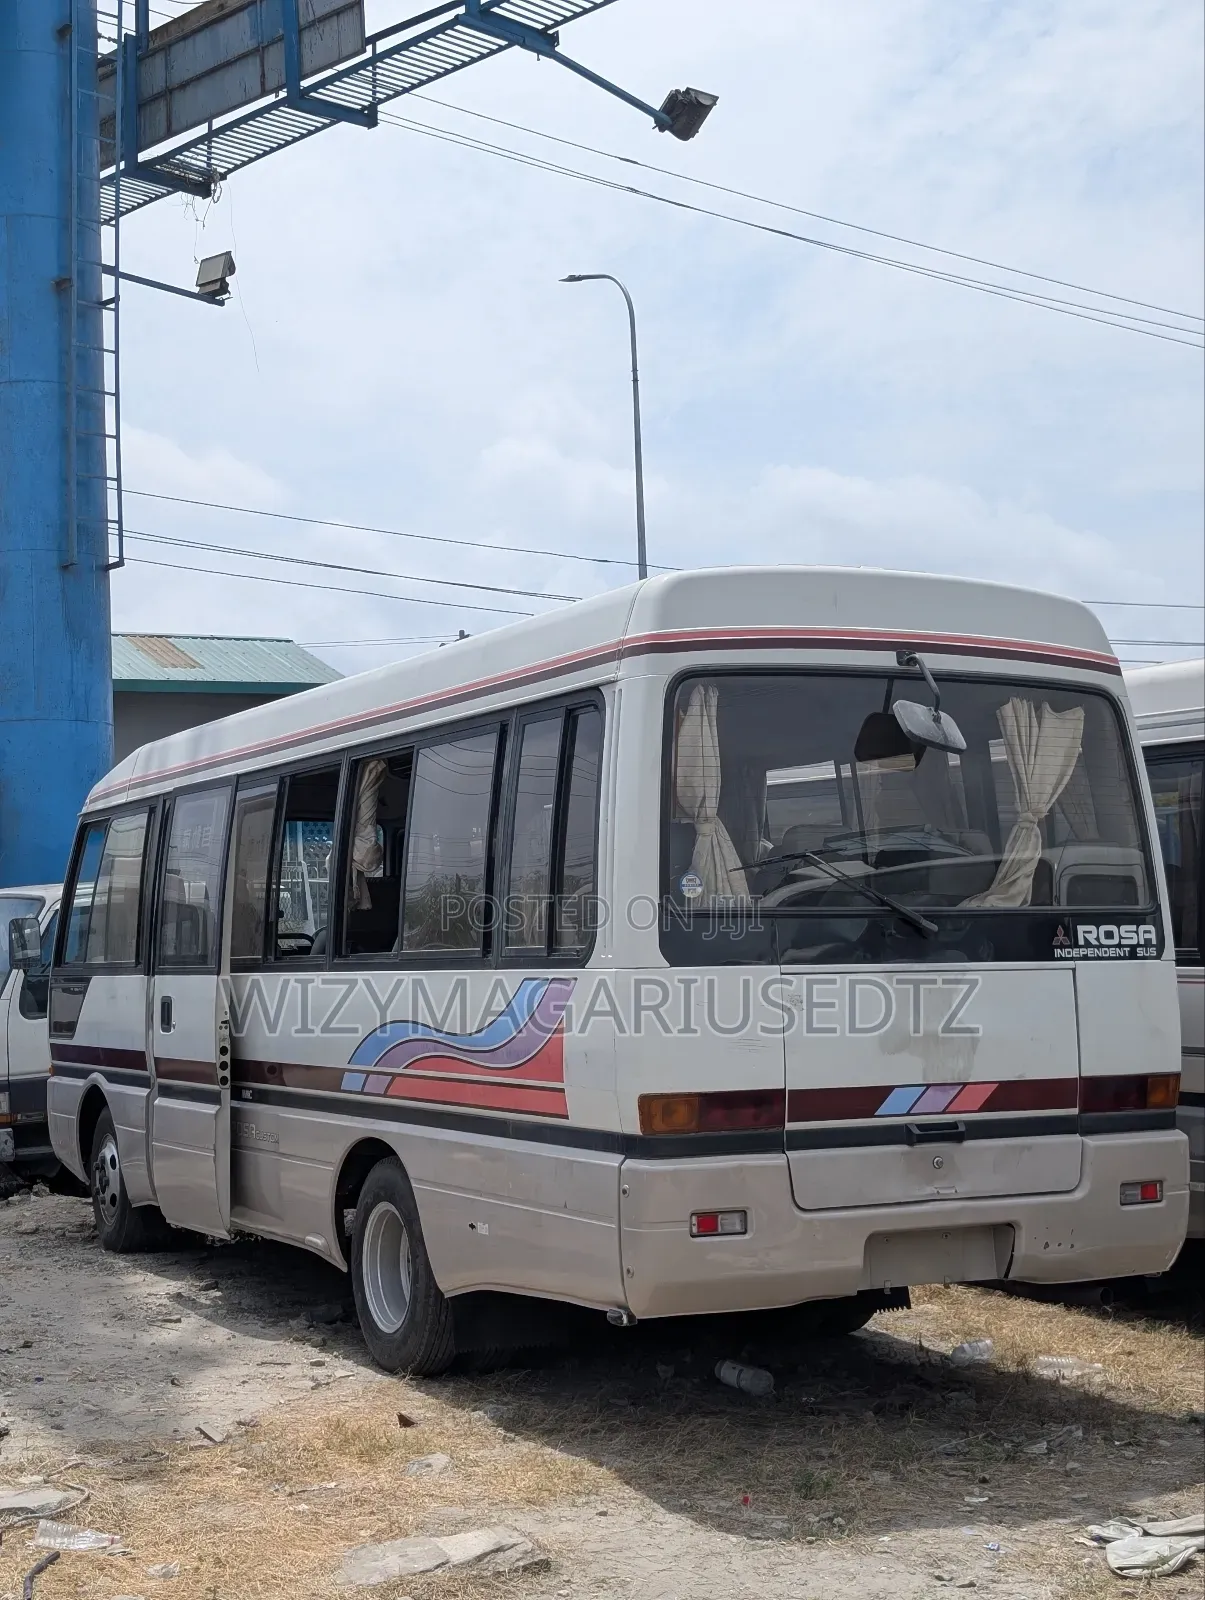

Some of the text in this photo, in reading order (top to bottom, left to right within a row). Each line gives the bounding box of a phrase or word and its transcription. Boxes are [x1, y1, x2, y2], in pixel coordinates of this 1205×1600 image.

[1076, 924, 1157, 946] ROSA
[1054, 947, 1157, 958] INDEPENDENT SUS
